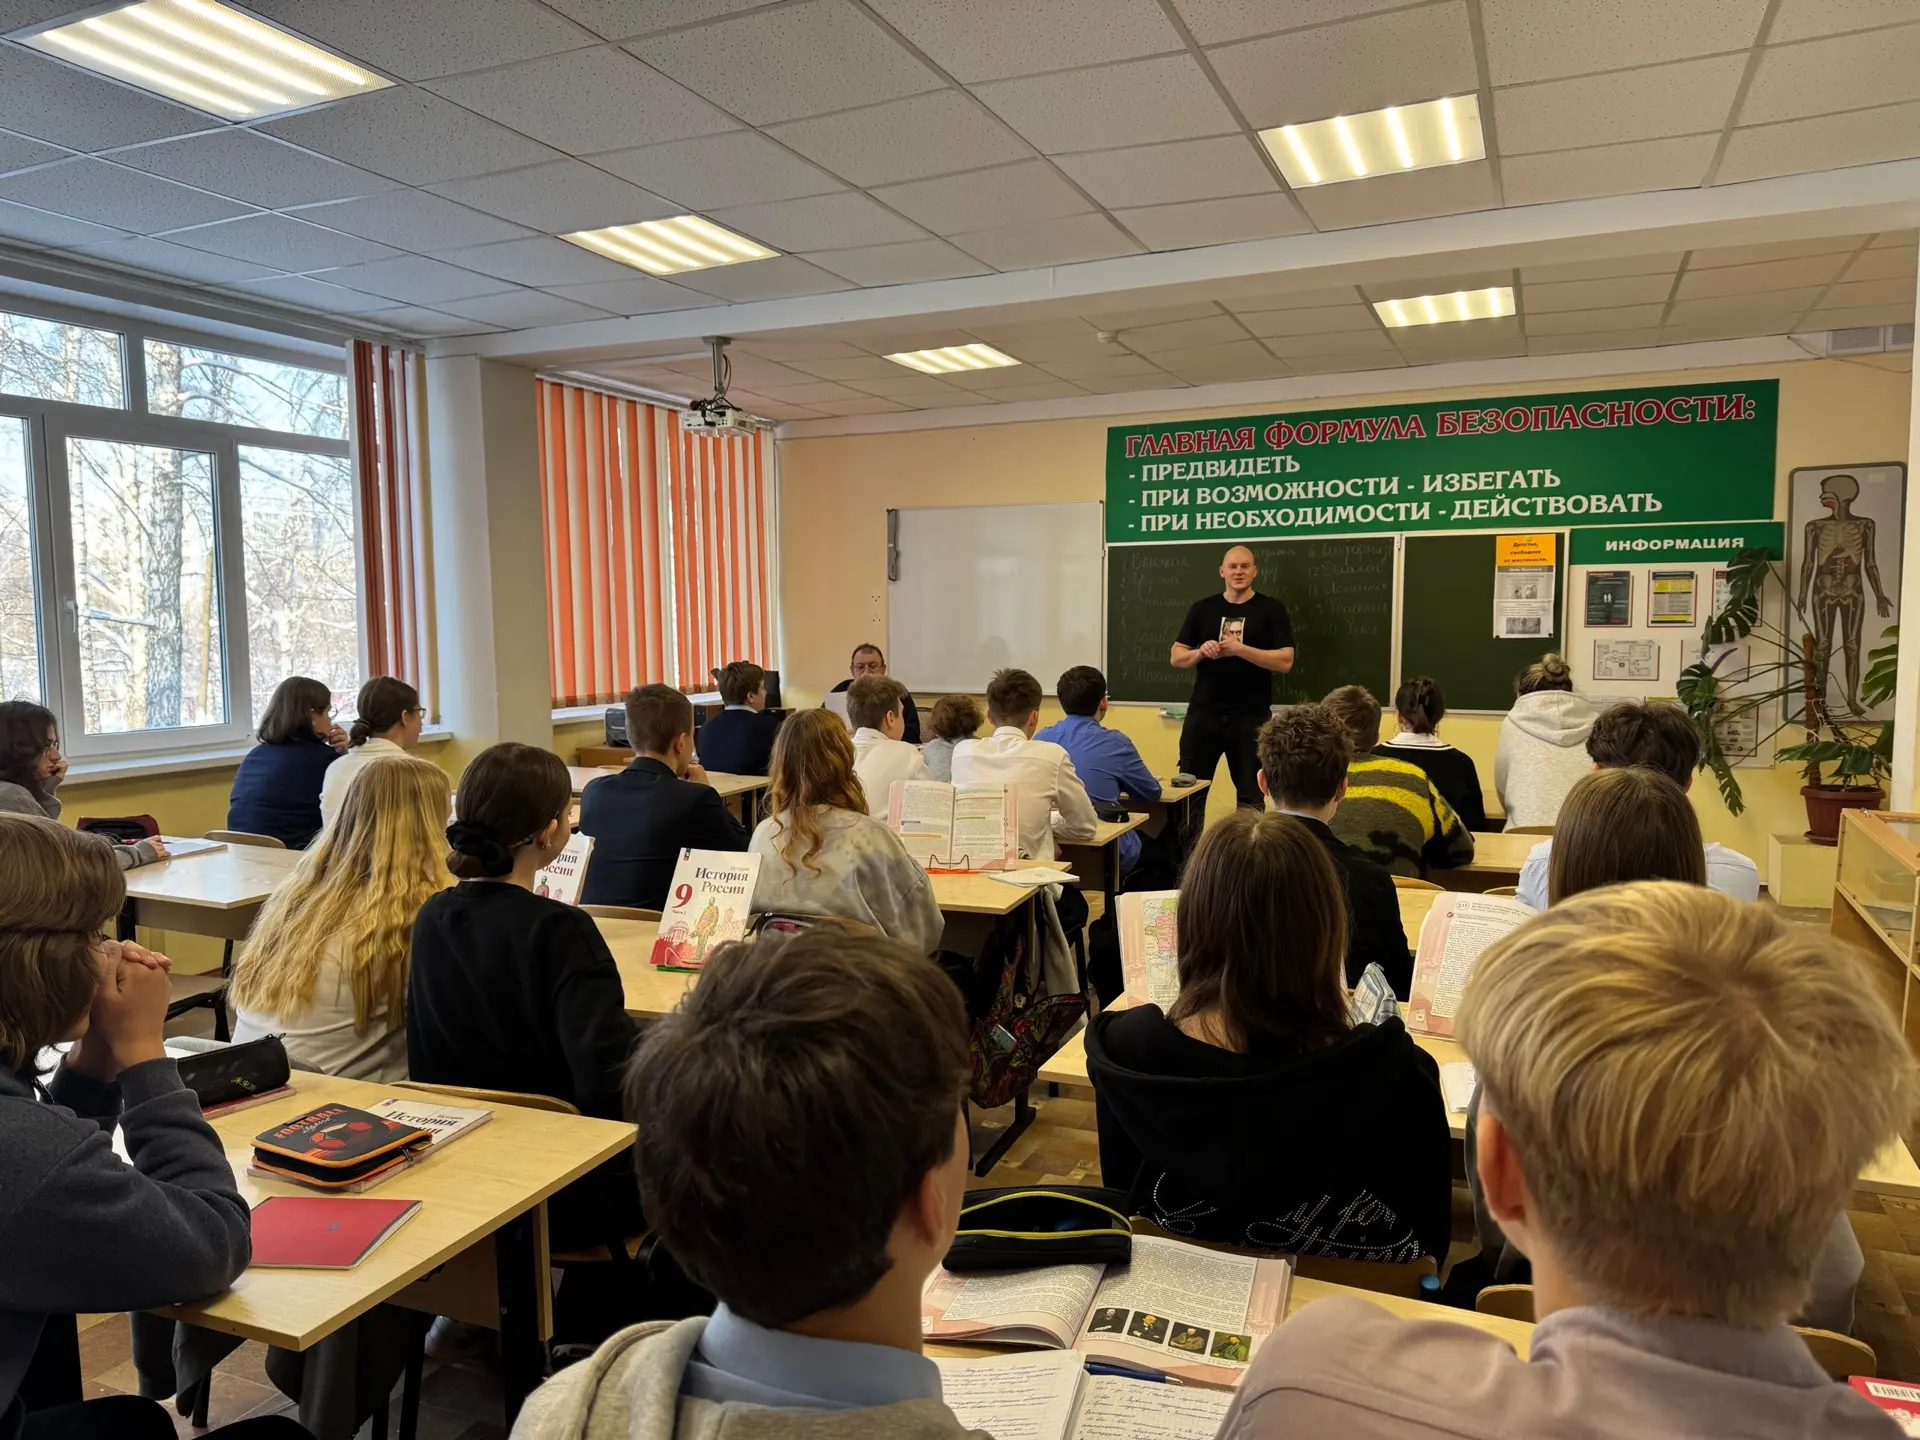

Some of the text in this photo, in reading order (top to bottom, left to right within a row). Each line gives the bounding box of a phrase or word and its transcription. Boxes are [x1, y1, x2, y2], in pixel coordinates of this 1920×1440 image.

[1125, 393, 1756, 458] ГЛАВНАЯ ФОРМУЛА БЕЗОПАСНОСТИ:
[1141, 455, 1301, 482] ПРЕДВИДЕТЬ
[1141, 488, 1190, 507] ПРИ
[1196, 476, 1400, 505] ВОЗМОЖНОСТИ
[1422, 468, 1561, 493] ИЗБЕГАТЬ
[1140, 513, 1189, 532] ПРИ
[1195, 501, 1431, 530] НЕОБХОДИМОСТИ
[1450, 493, 1663, 521] ДЕЙСТВОВАТЬ
[1605, 537, 1745, 551] ИНФОРМАЦИЯ
[542, 865, 574, 876] оссии
[694, 867, 749, 882] История
[671, 883, 693, 909] 9
[700, 881, 745, 895] России
[273, 1108, 348, 1139] FOOTBALL
[384, 1110, 459, 1127] История
